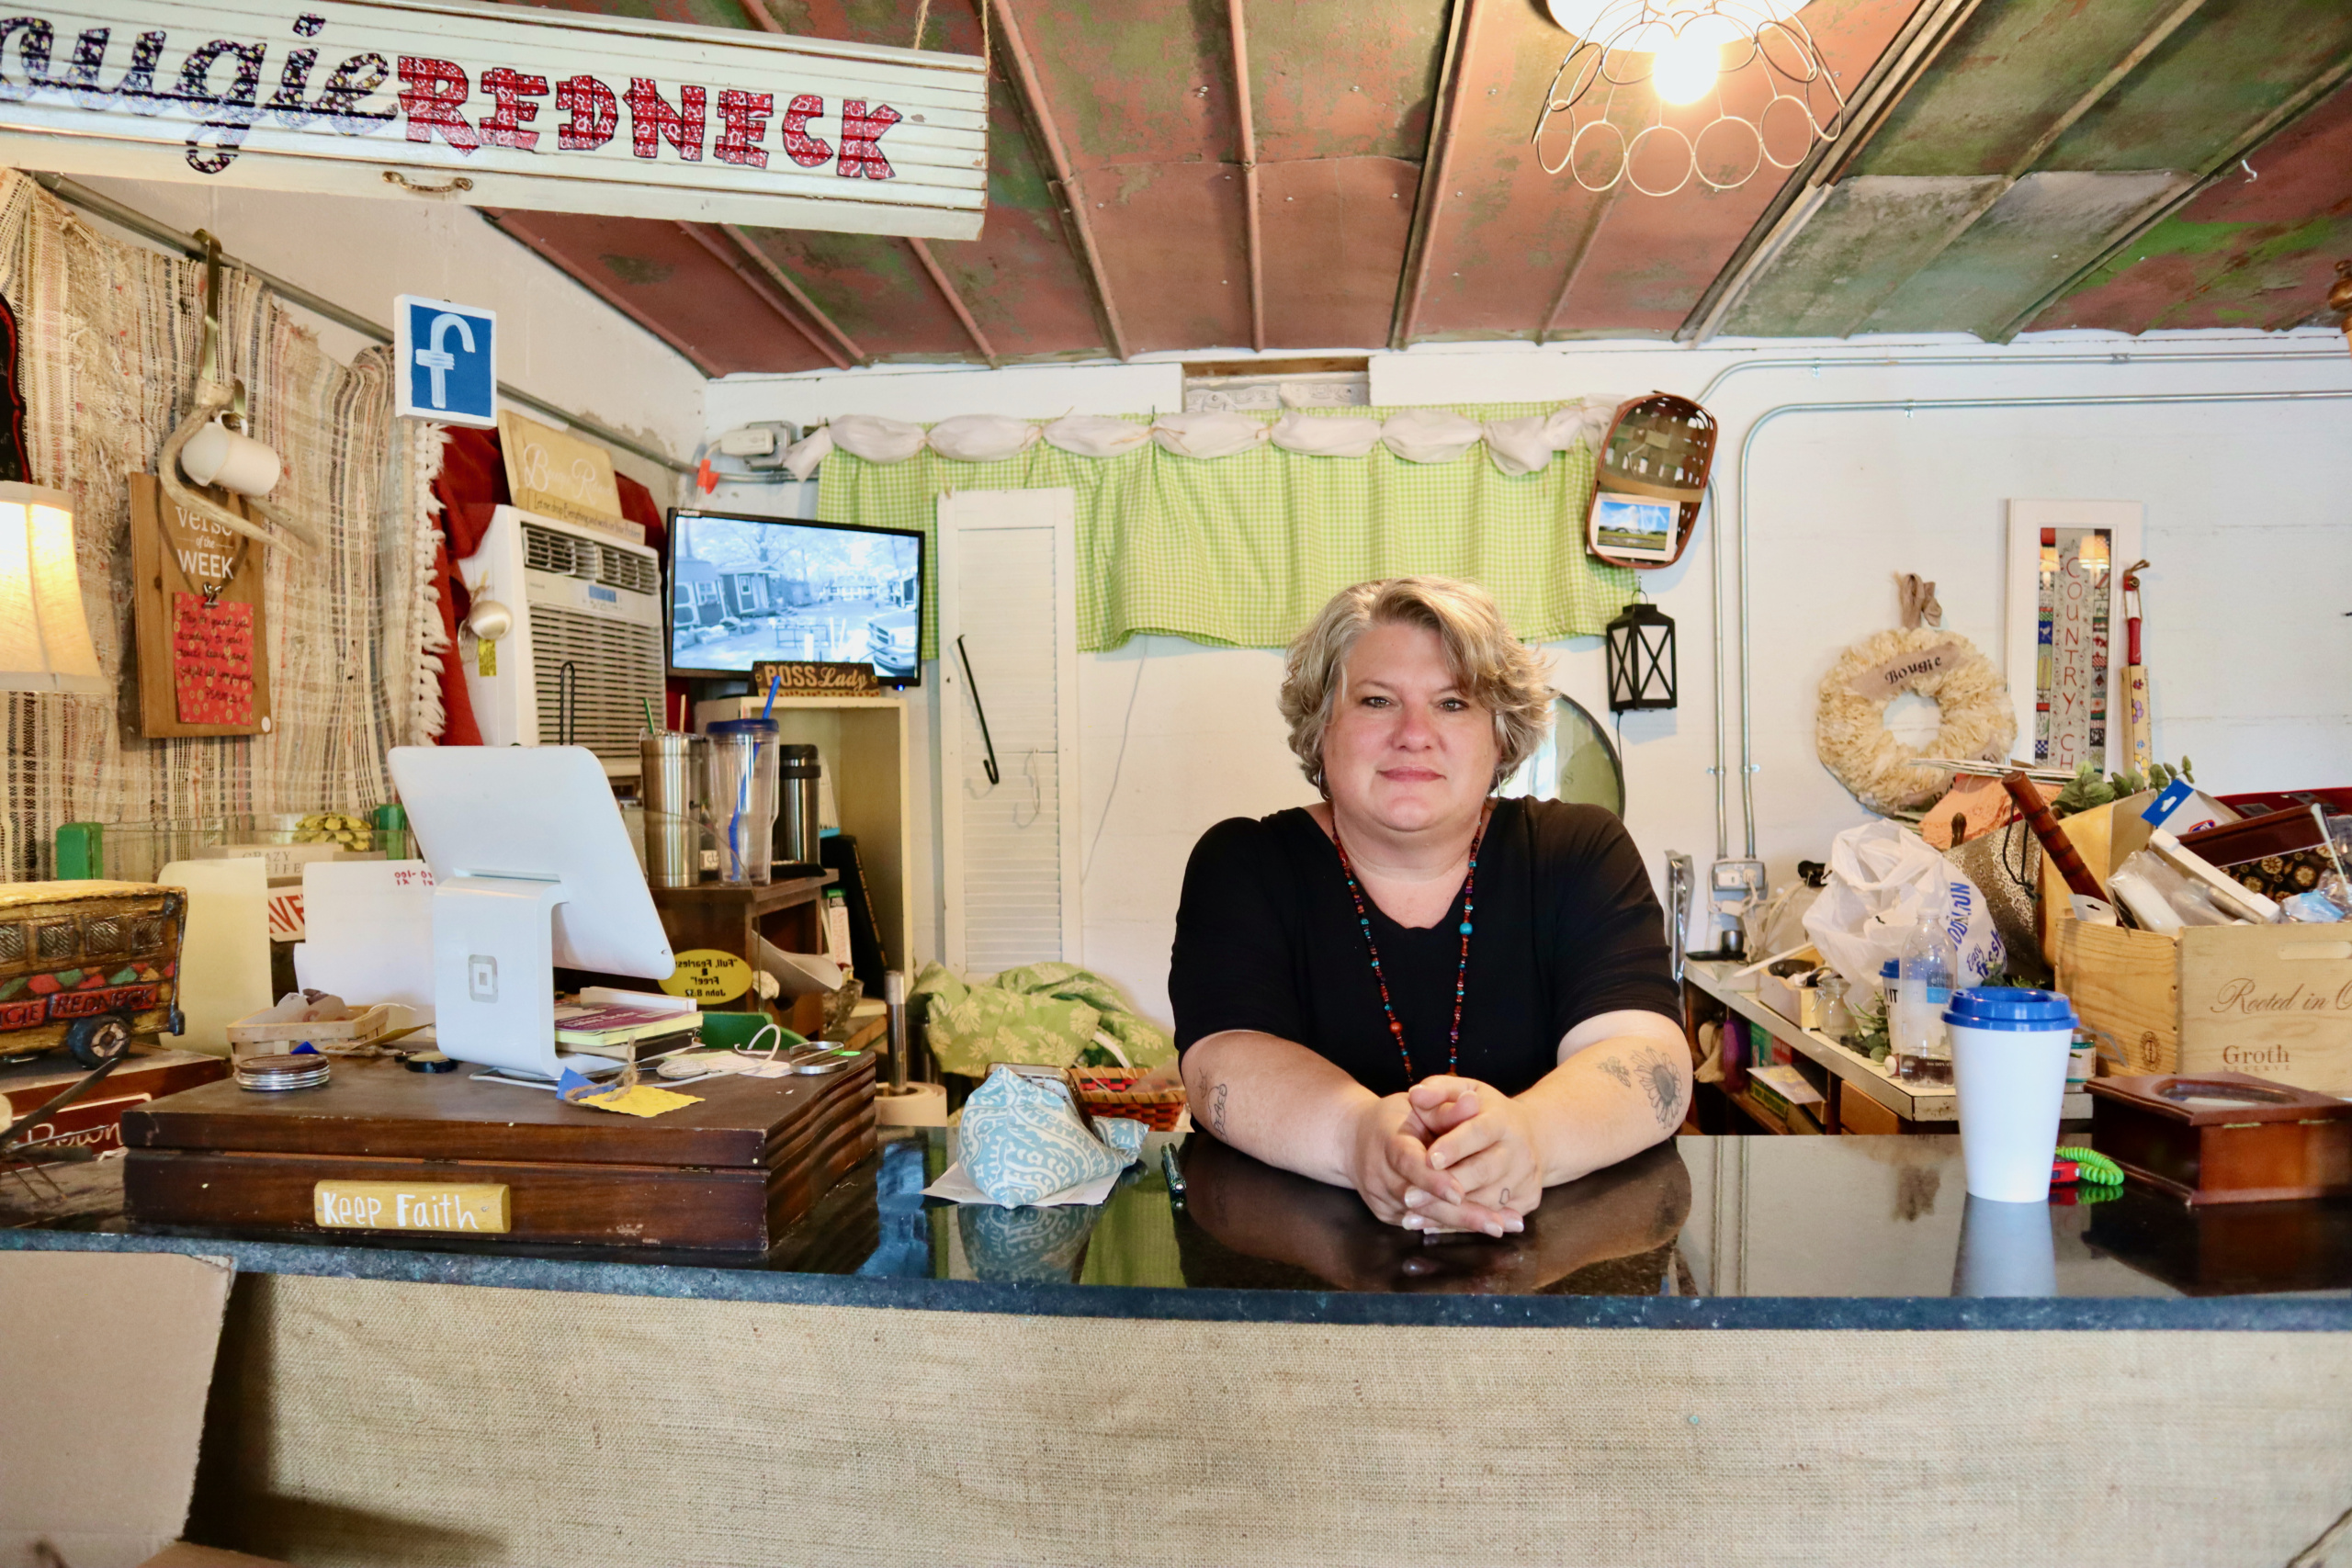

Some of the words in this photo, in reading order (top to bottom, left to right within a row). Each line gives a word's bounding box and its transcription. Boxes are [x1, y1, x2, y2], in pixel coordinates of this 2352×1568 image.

[397, 55, 904, 180] REDNECK
[196, 535, 204, 548] of
[204, 536, 215, 548] the
[176, 548, 234, 580] WEEK
[2062, 556, 2083, 716] COUNTRY
[764, 665, 816, 688] BOSS
[818, 667, 868, 692] Lady
[1884, 656, 1942, 685] Bougie
[2210, 977, 2305, 1014] Rooted
[2302, 993, 2330, 1010] in
[2222, 1043, 2290, 1065] Groth
[322, 1192, 382, 1227] Keep
[396, 1193, 479, 1230] Faith
